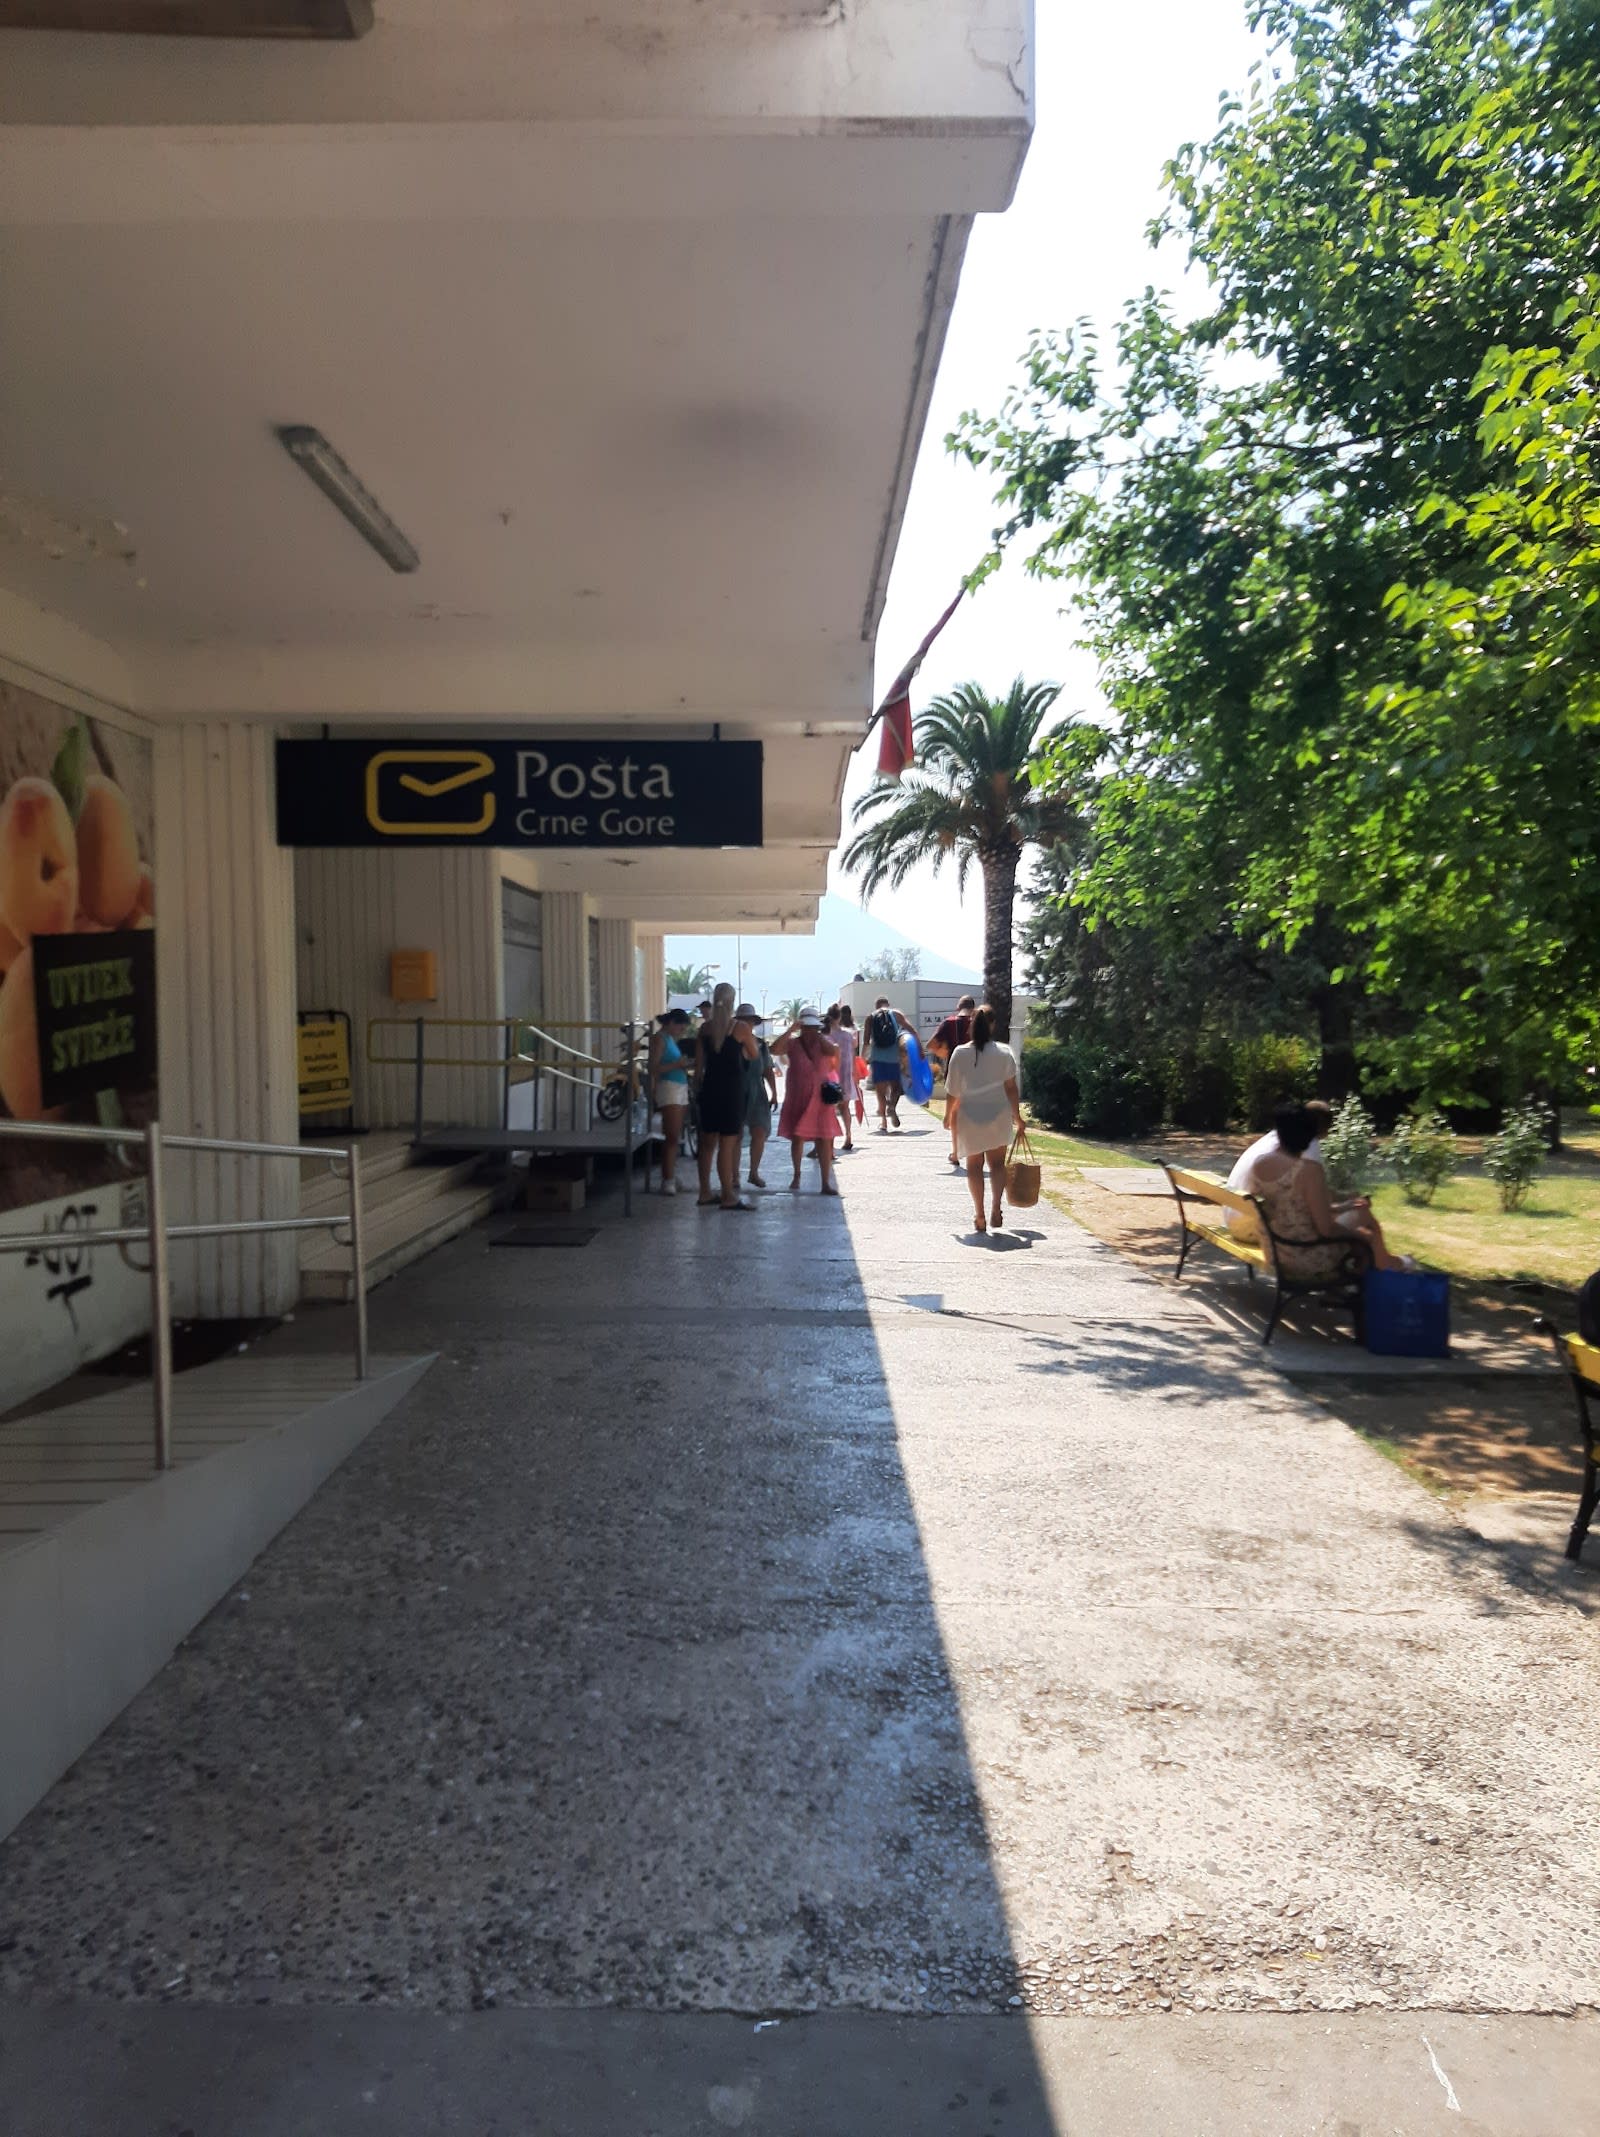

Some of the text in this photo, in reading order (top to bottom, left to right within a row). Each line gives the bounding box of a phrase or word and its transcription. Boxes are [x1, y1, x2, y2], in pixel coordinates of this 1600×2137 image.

[516, 751, 674, 799] Pošta
[516, 809, 675, 835] Crne Gore
